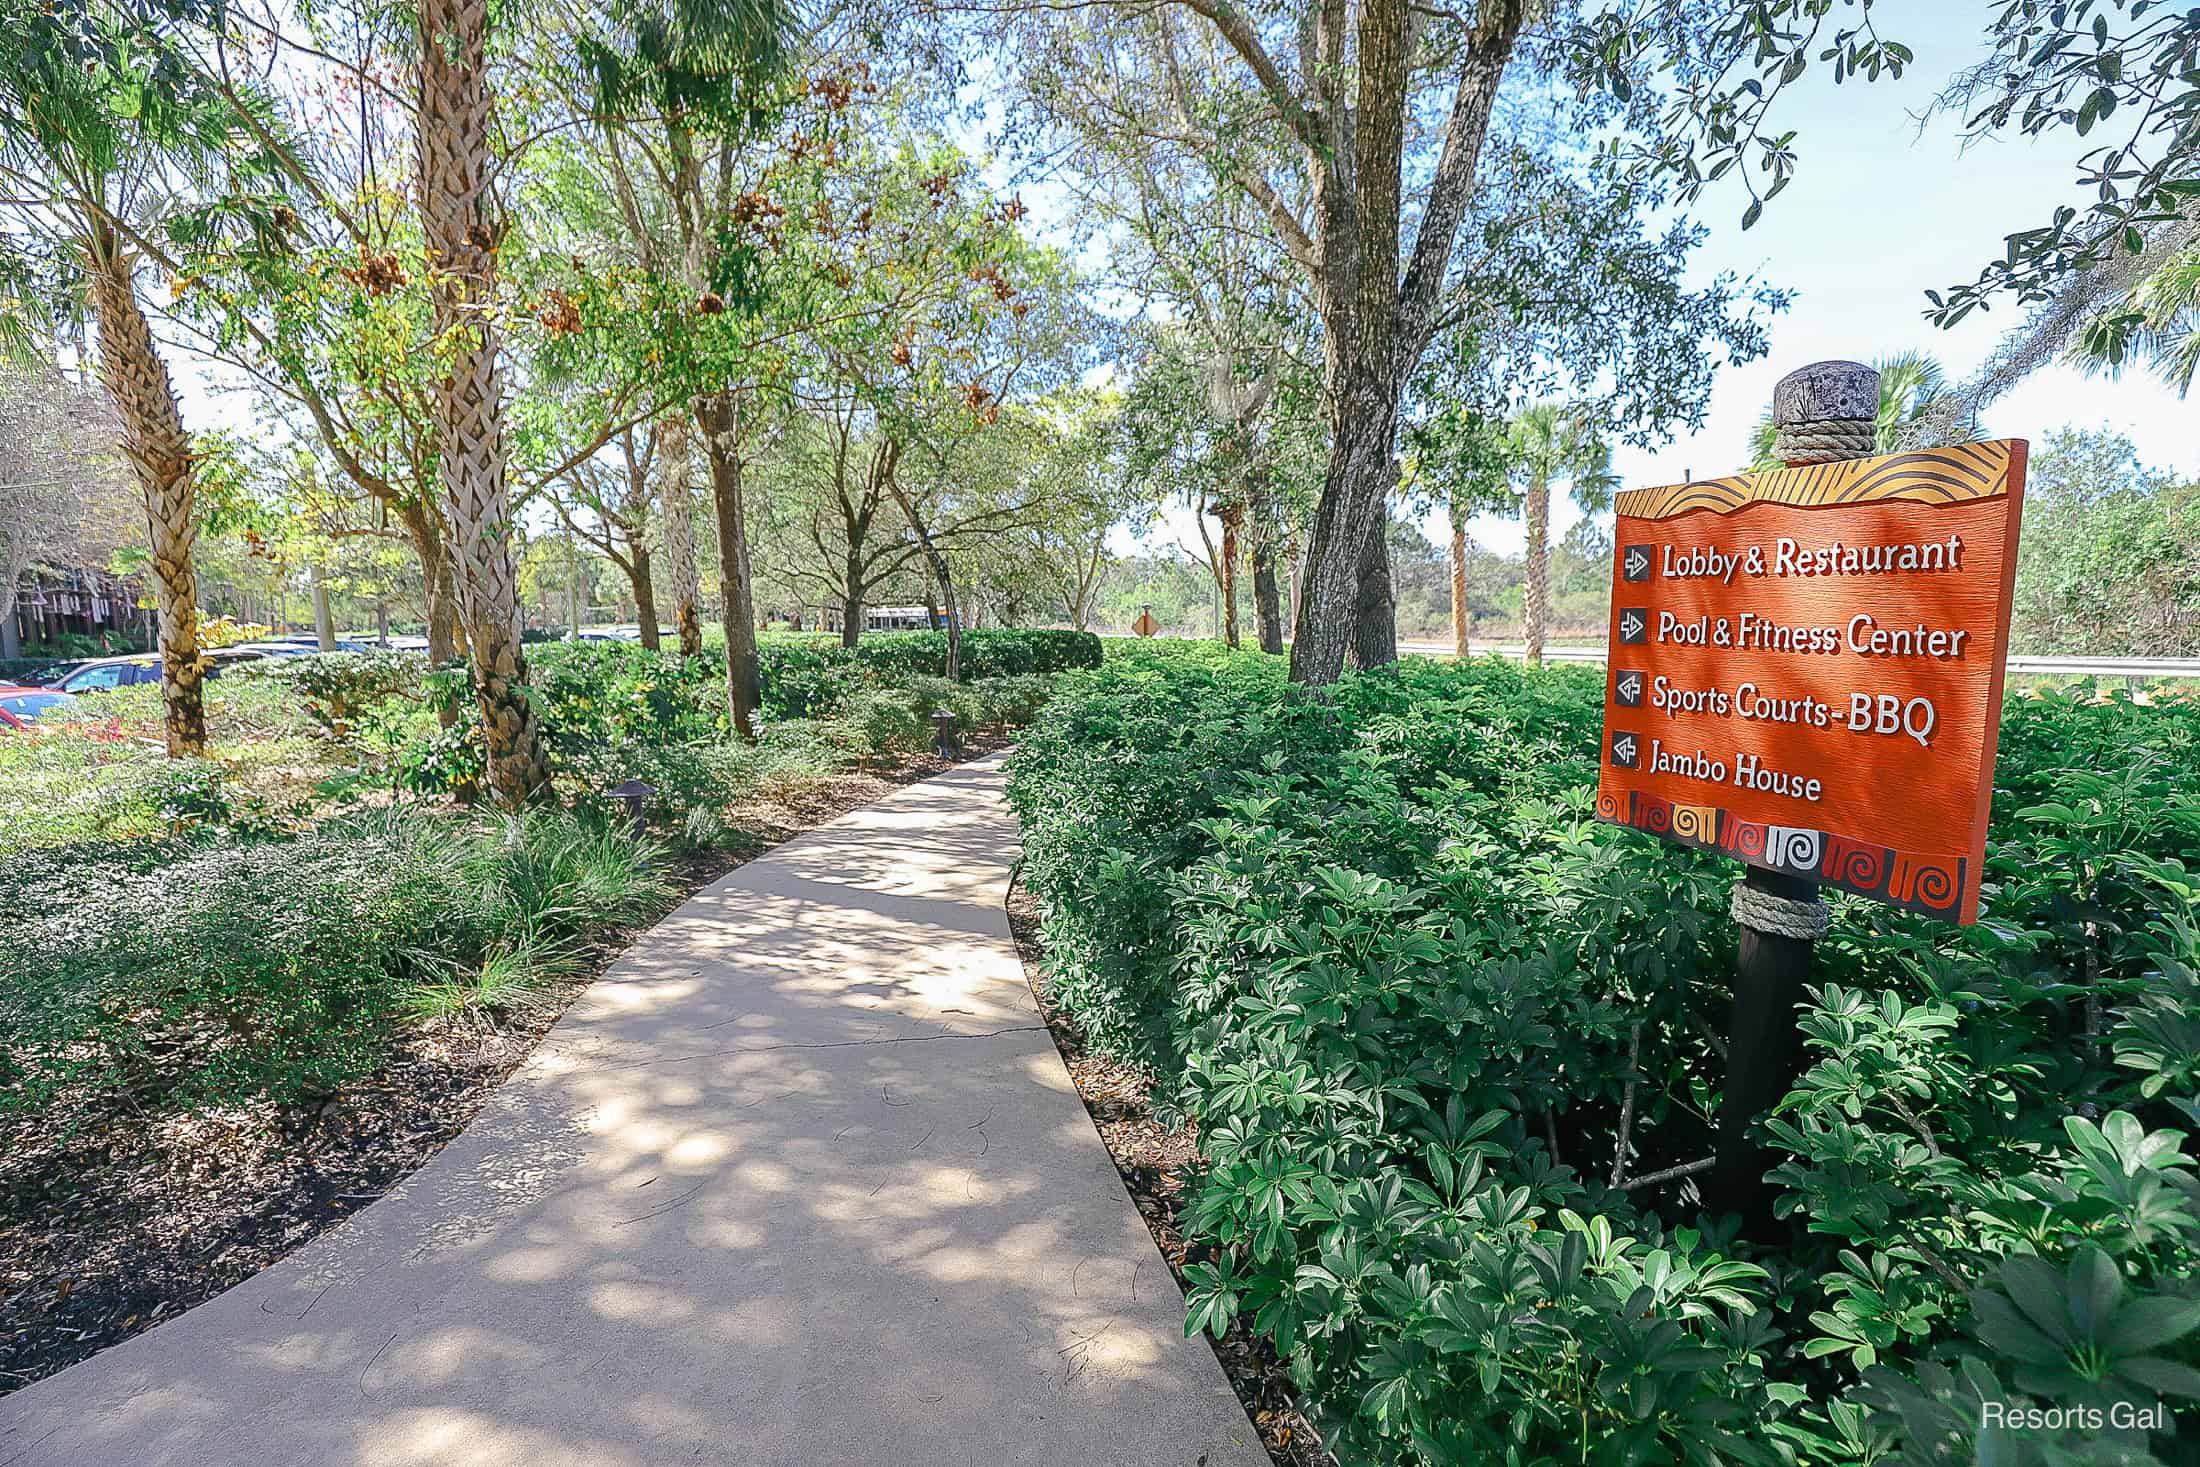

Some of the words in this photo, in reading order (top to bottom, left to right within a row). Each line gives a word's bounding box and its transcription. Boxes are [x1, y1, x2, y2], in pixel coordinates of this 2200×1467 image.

[1662, 545, 1740, 584] Lobby
[1744, 545, 1764, 575] &
[1774, 535, 1963, 577] Restaurant
[1656, 612, 1707, 645] Pool
[1713, 618, 1730, 646] &
[1737, 612, 1838, 653] Fitness
[1847, 613, 1966, 657] Center
[1652, 676, 1728, 715] Sports
[1650, 739, 1726, 782] Jambo
[1734, 753, 1823, 801] House
